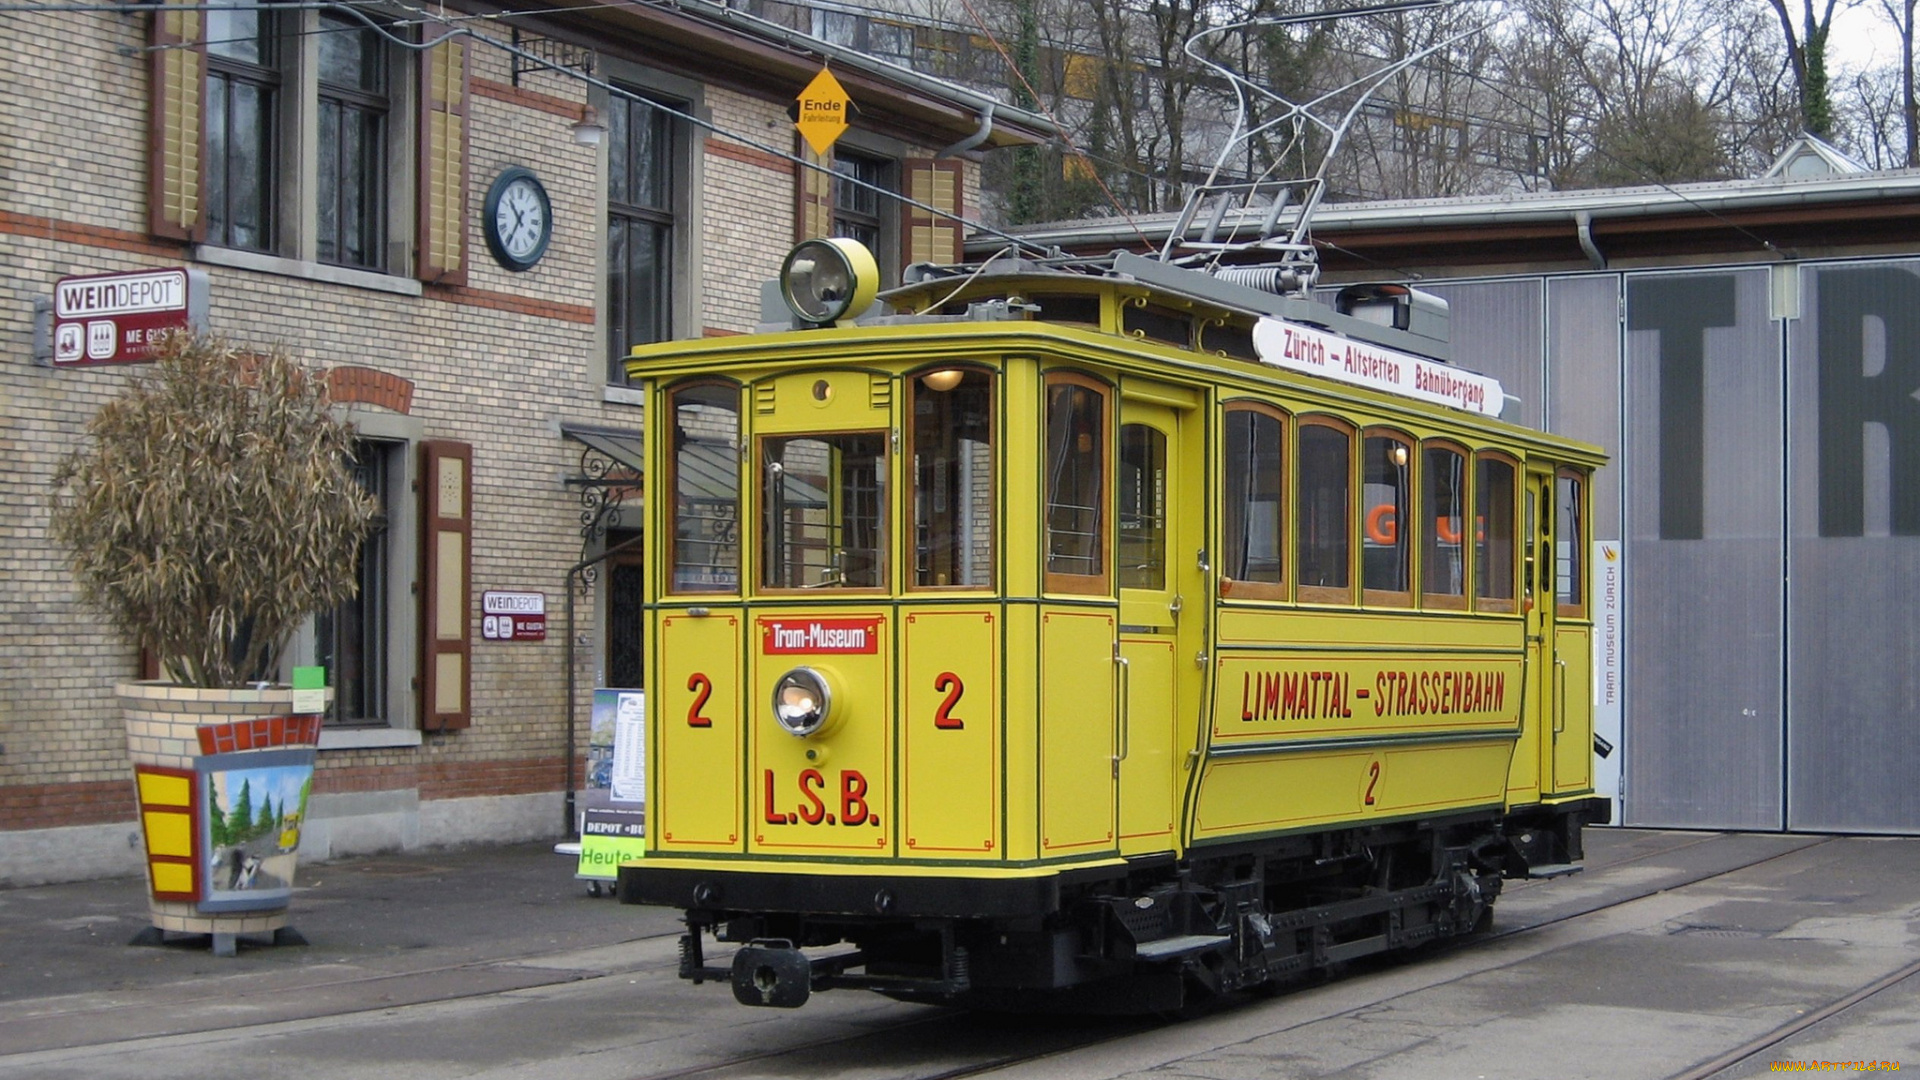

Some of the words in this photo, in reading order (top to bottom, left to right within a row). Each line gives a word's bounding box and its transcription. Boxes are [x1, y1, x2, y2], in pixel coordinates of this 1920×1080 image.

[804, 100, 841, 111] Ende
[126, 329, 142, 344] ME
[1284, 329, 1325, 366] Zürich
[1344, 346, 1400, 384] Altstetten
[1415, 363, 1484, 412] Bahnübergang
[1605, 566, 1615, 609] ZÜRICH
[772, 624, 865, 648] Tram-Museum
[1605, 613, 1615, 668] MUSEUM
[687, 672, 712, 728] 2
[934, 672, 964, 730] 2
[1605, 671, 1615, 706] TRAM
[764, 768, 880, 826] L.S.B.
[1365, 761, 1380, 805] 2
[587, 822, 622, 833] DEPOT
[581, 848, 632, 865] Heute
